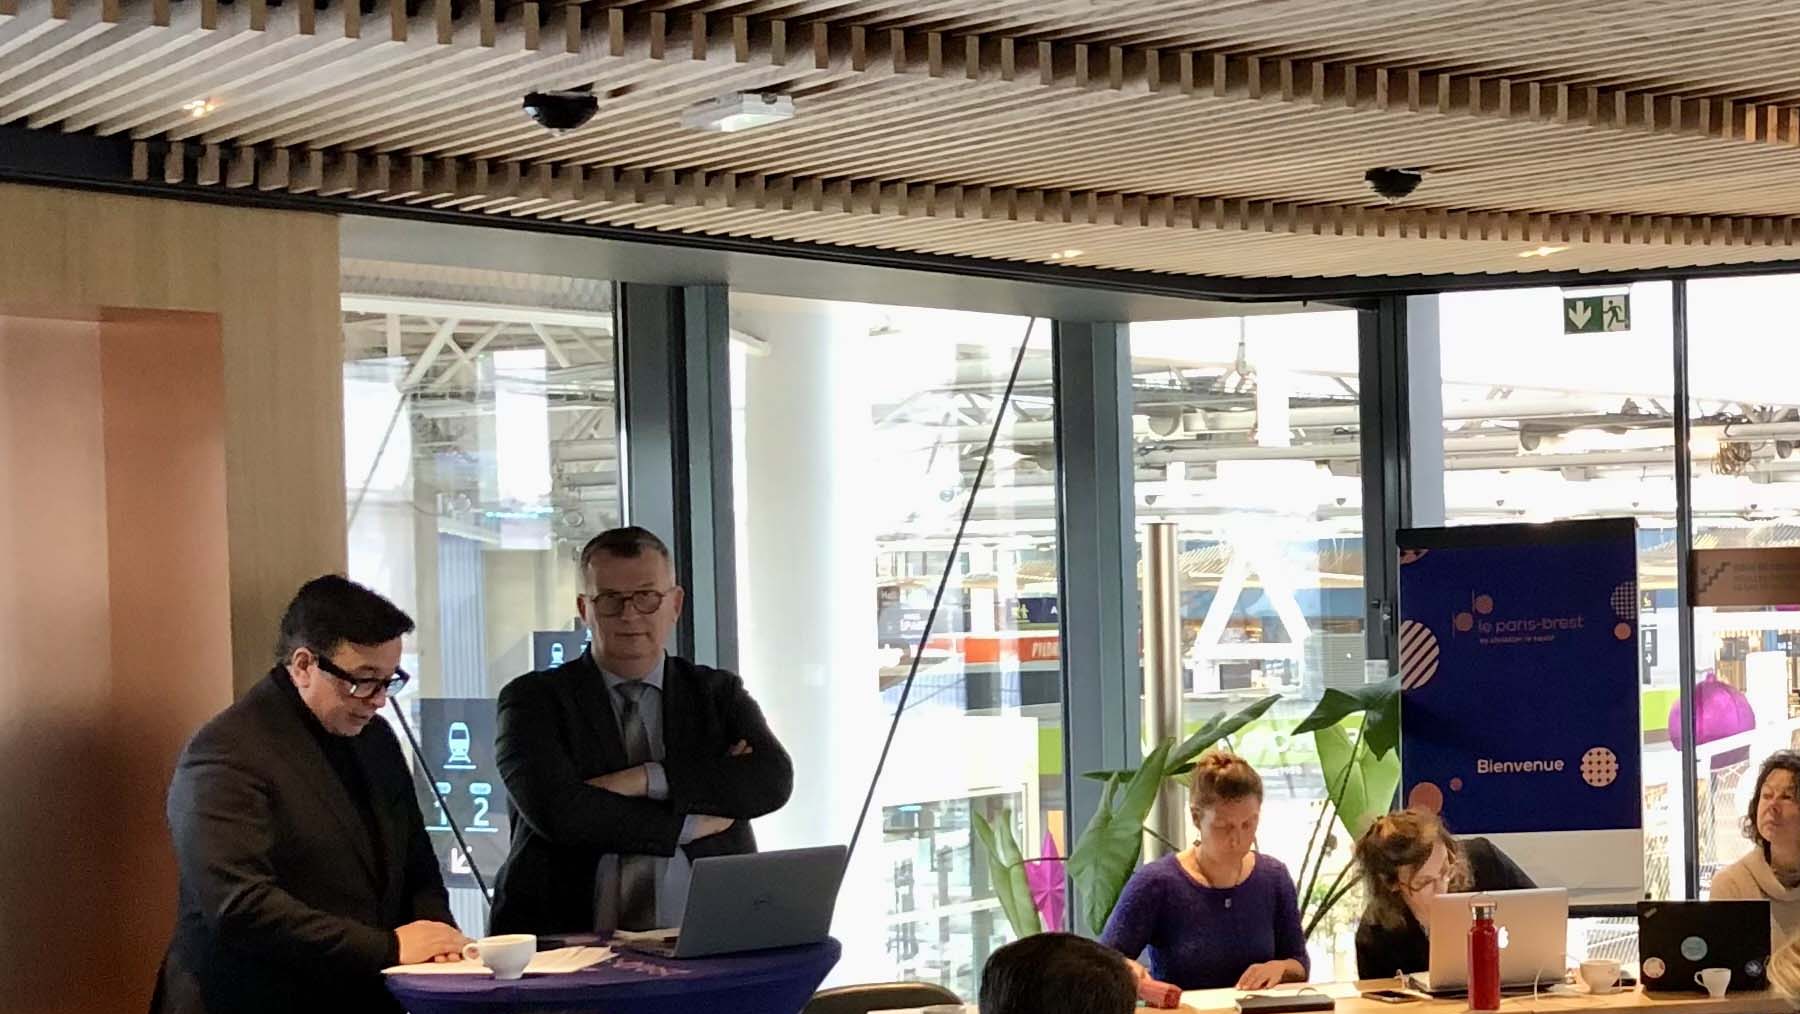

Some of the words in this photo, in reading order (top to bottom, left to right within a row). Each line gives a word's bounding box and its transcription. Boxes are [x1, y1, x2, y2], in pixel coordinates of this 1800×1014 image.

[1495, 615, 1584, 633] paris-brest
[1477, 759, 1565, 774] Bienvenue
[473, 796, 490, 826] 2
